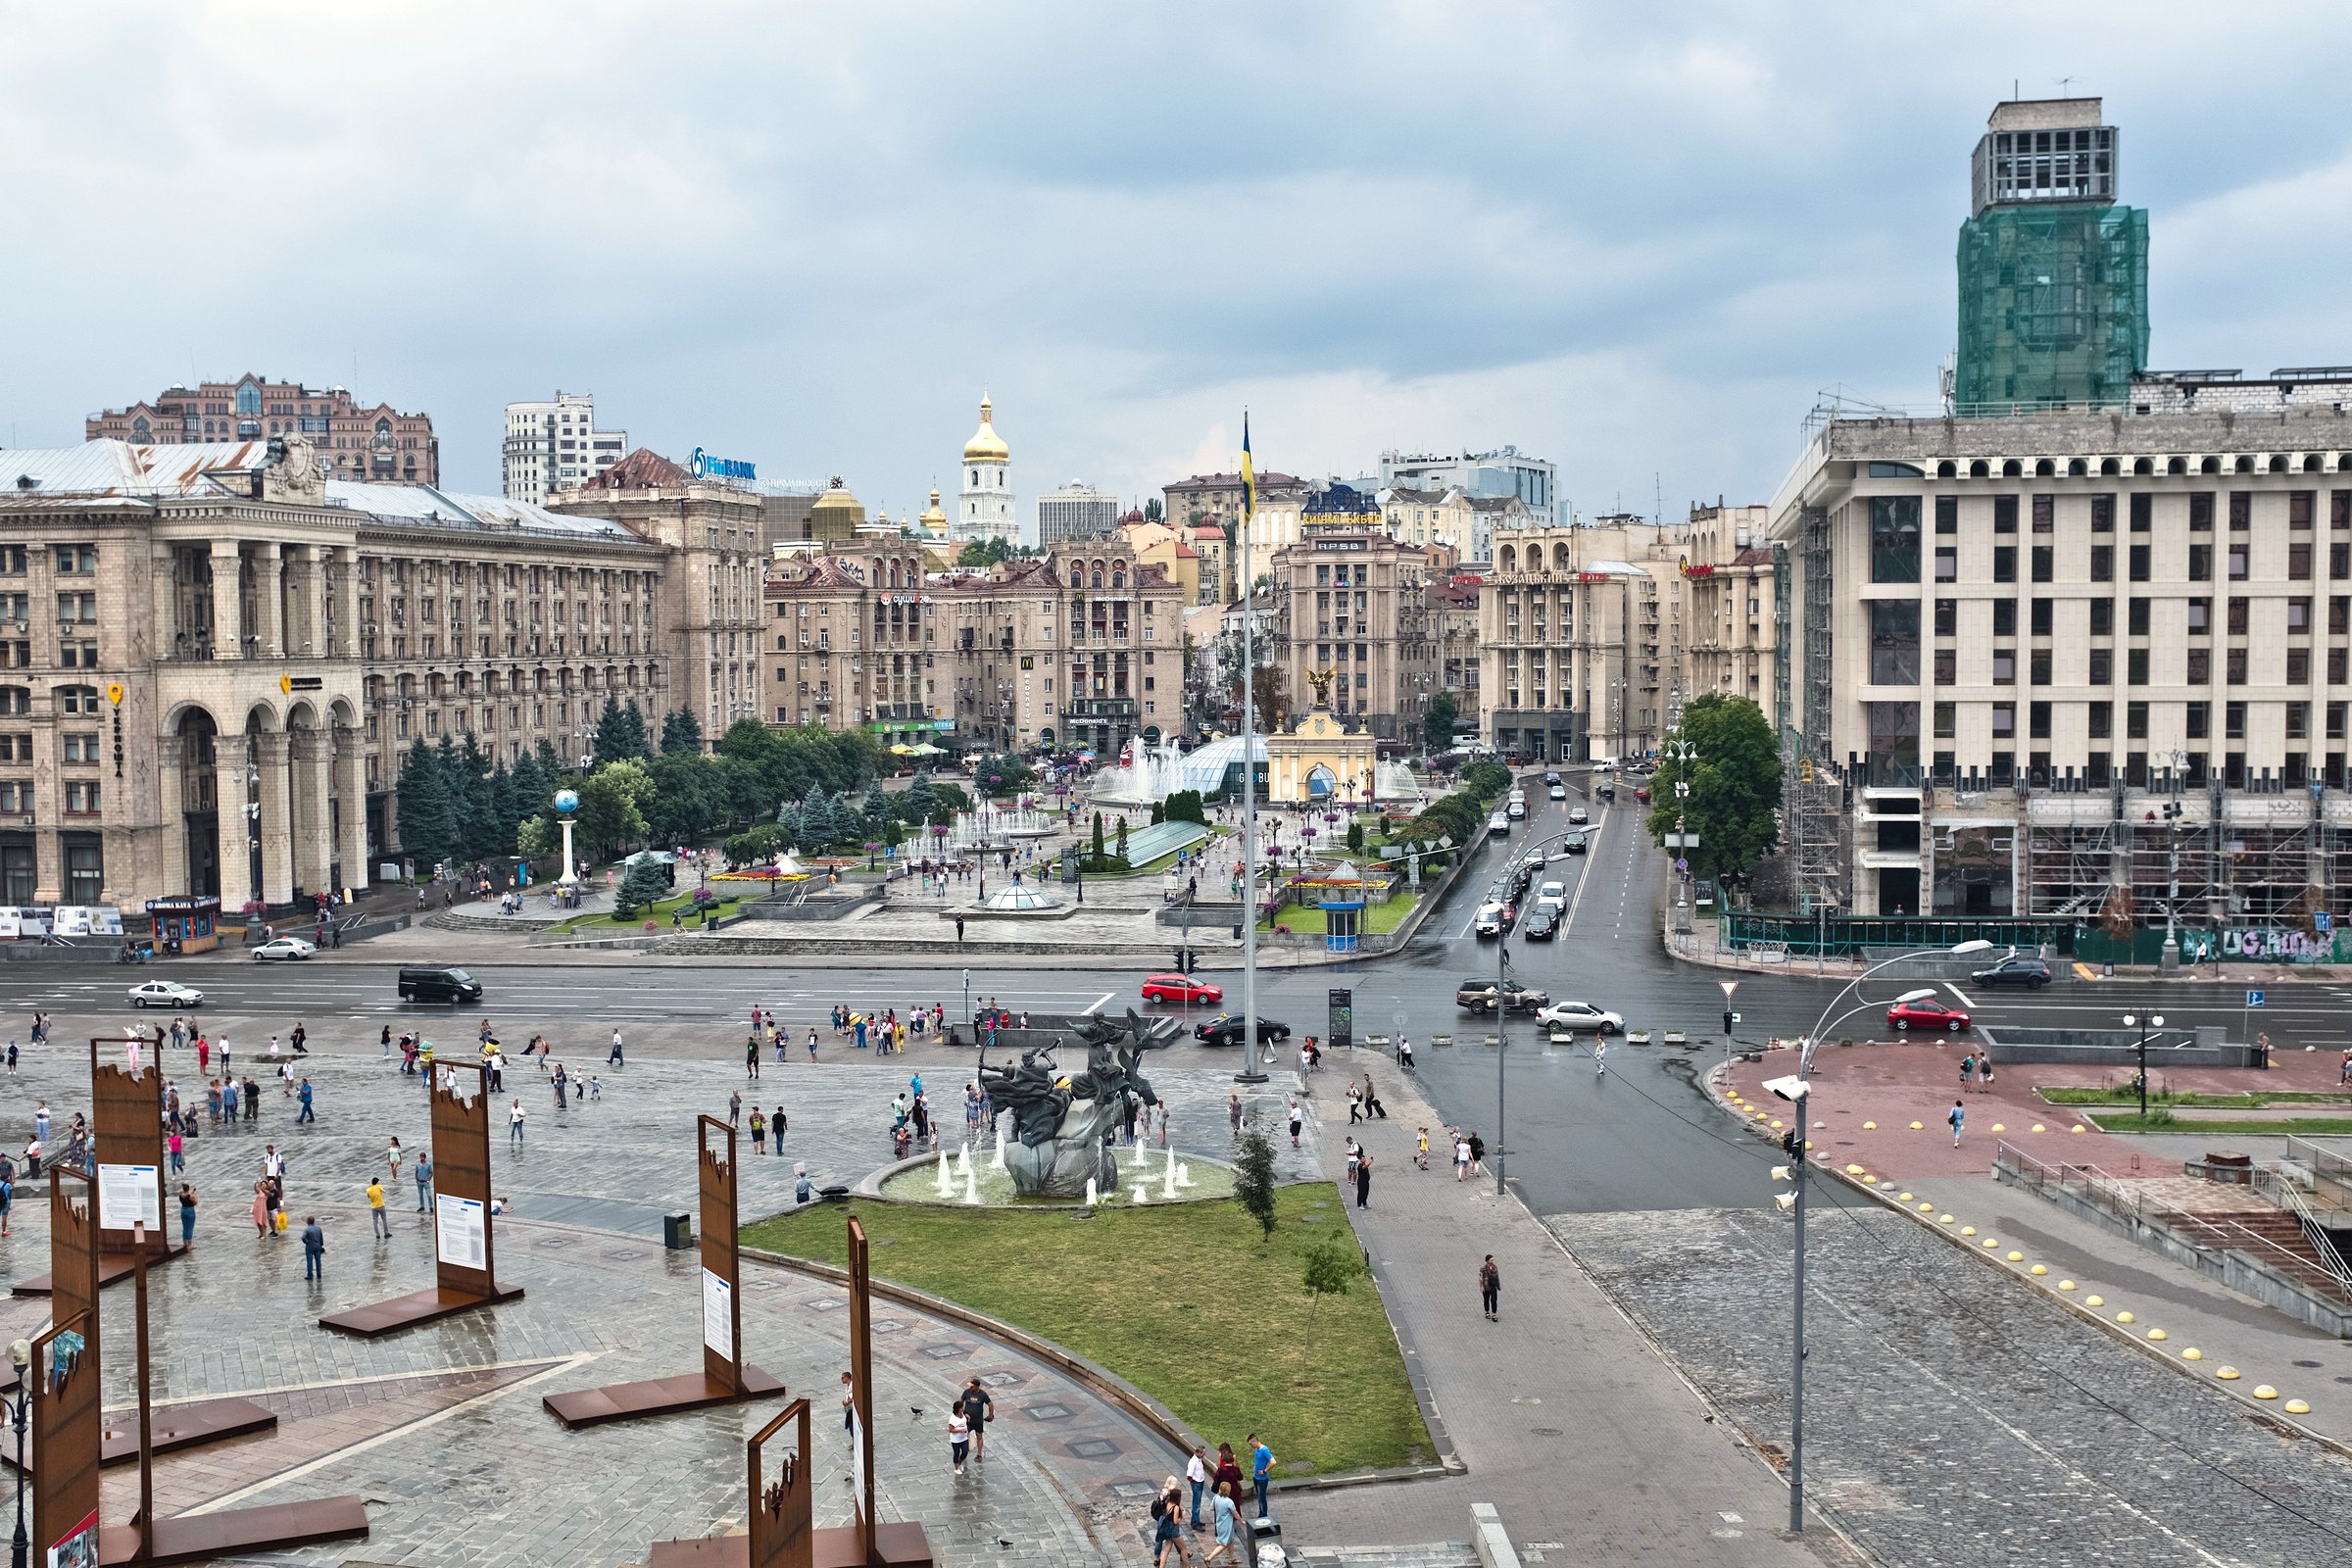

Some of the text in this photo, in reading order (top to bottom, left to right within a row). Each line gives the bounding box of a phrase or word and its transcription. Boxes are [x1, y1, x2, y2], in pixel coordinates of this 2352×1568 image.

[707, 456, 757, 480] FinBANK
[1498, 572, 1563, 585] КОЗАЦЬКИЙ
[113, 708, 123, 778] УКРПОШТА
